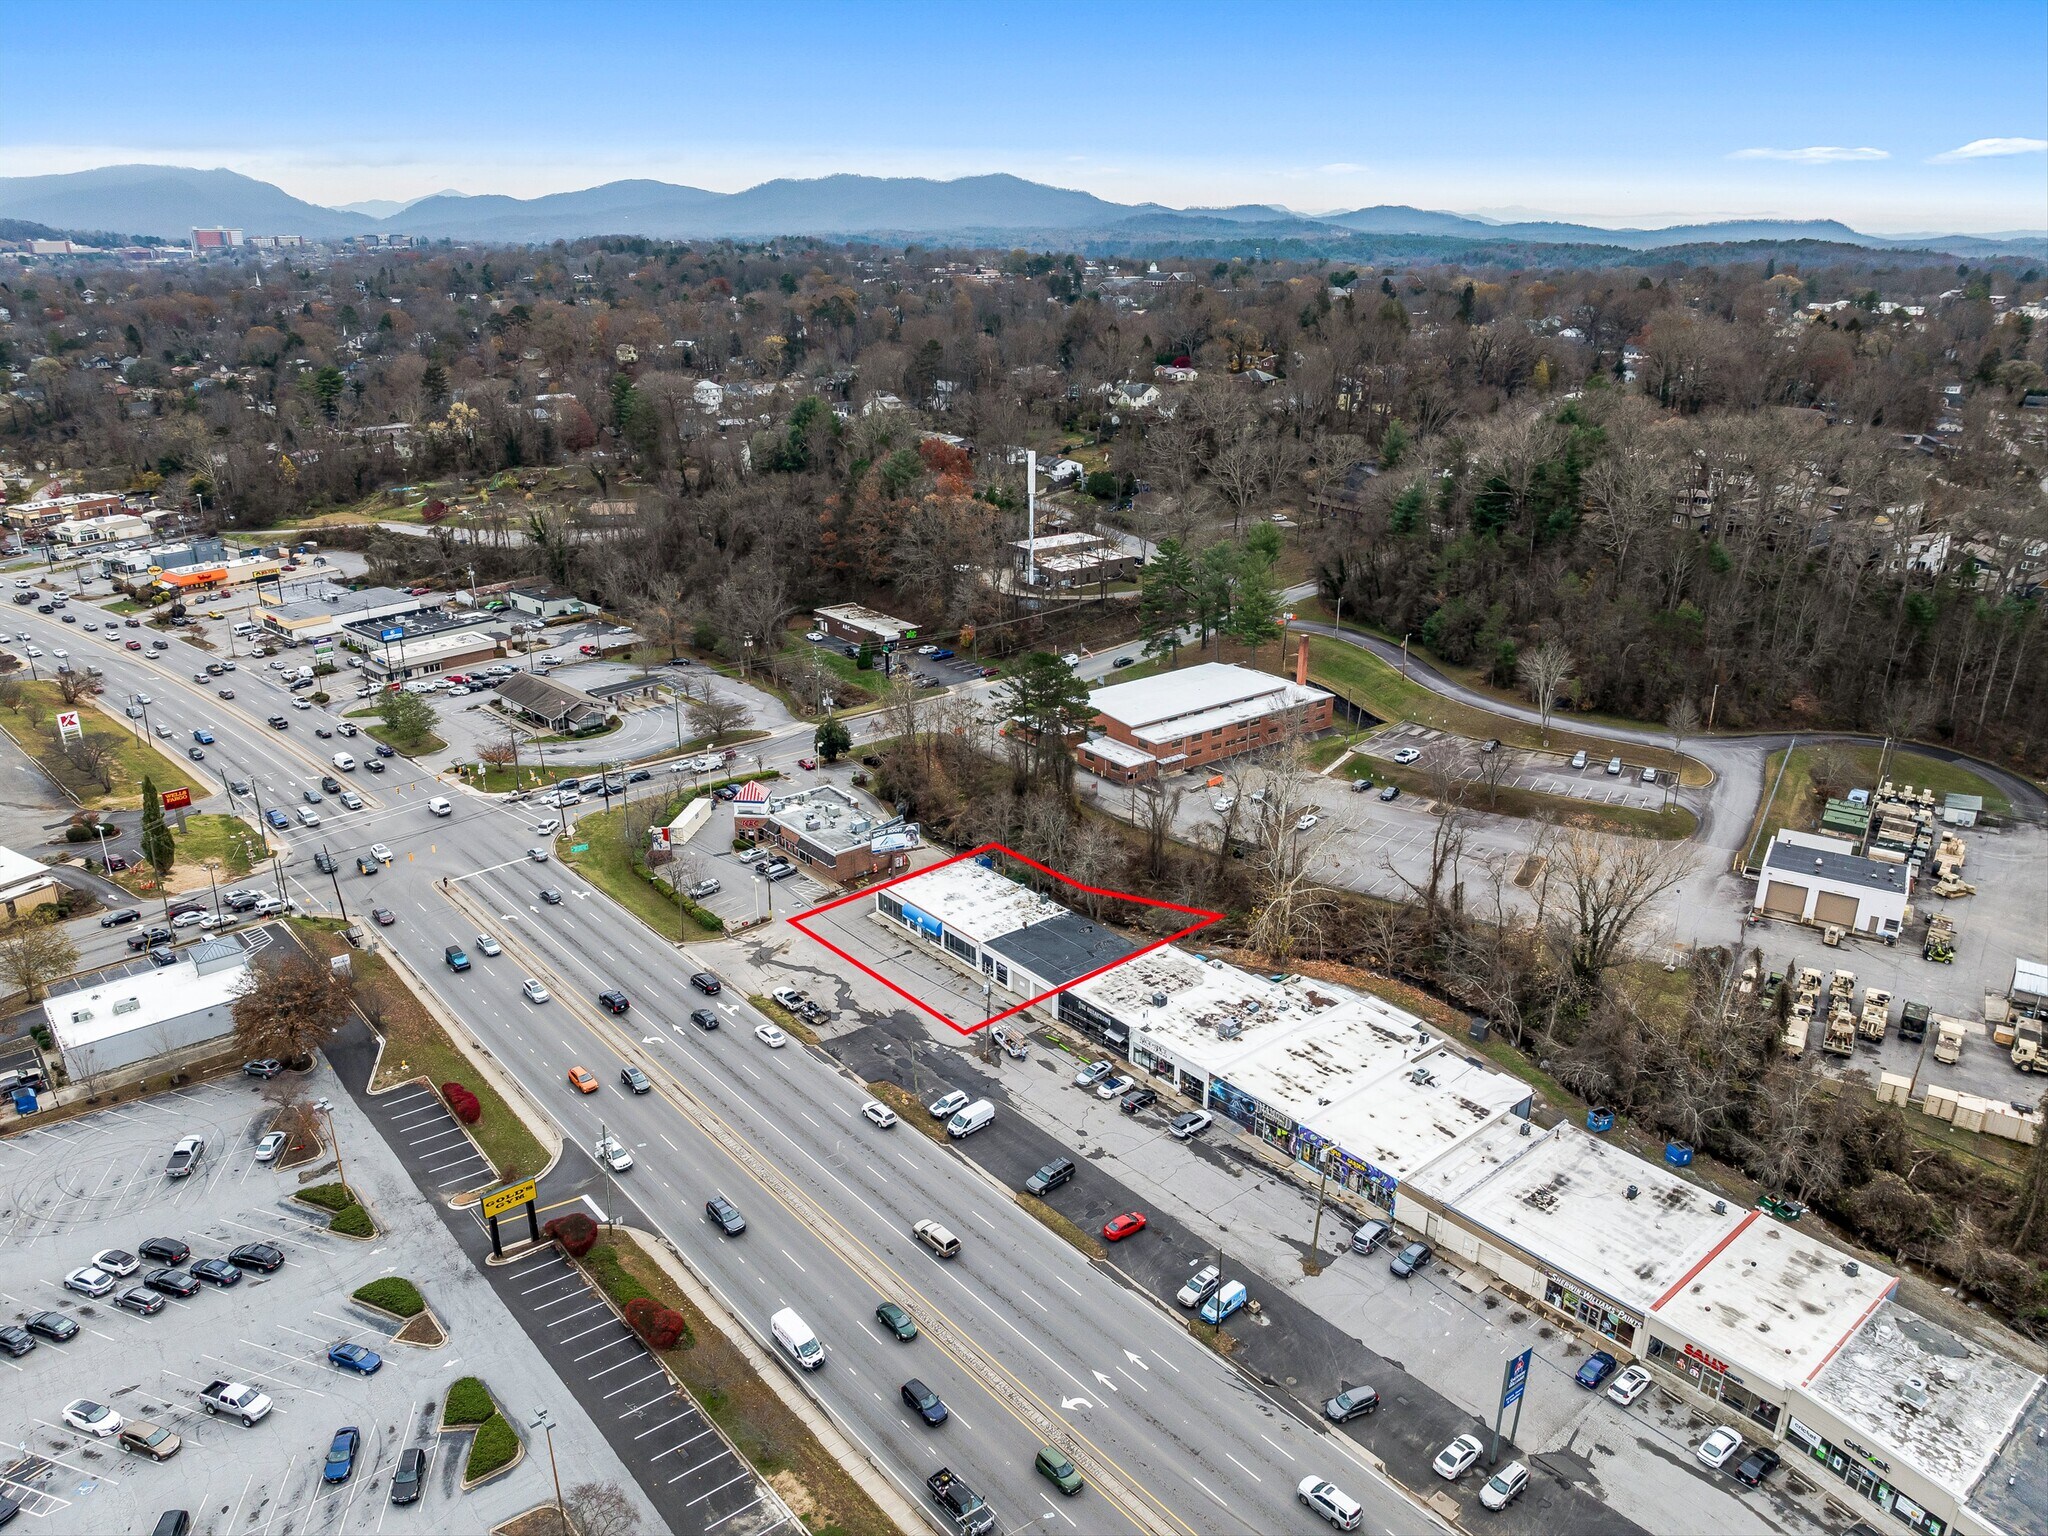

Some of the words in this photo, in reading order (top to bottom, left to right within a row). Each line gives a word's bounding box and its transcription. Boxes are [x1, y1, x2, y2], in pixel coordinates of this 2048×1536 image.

[165, 790, 187, 799] WELLS
[166, 795, 188, 803] FARGO
[741, 819, 759, 827] KFC
[485, 1185, 533, 1207] GOLD'S
[495, 1194, 525, 1209] GYM
[1617, 1310, 1643, 1329] PAINTS
[1683, 1343, 1729, 1374] SALLY
[1794, 1422, 1818, 1441] cricket
[1843, 1438, 1891, 1474] cricket
